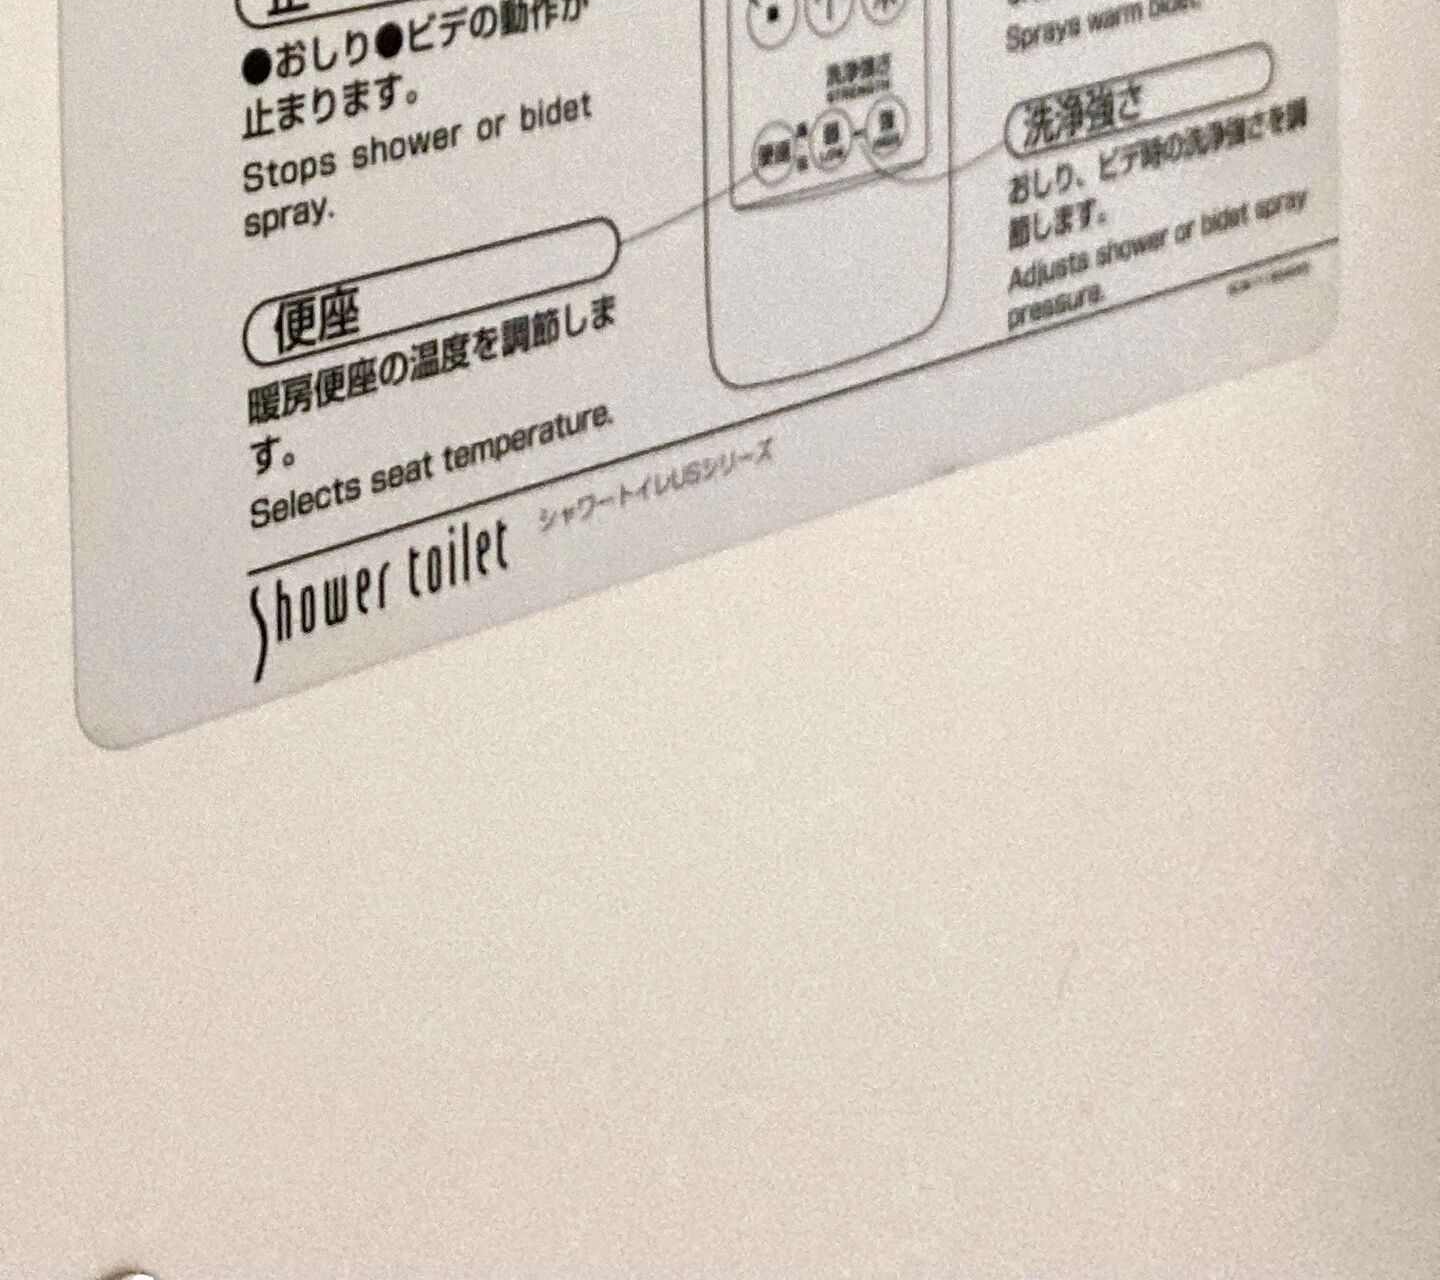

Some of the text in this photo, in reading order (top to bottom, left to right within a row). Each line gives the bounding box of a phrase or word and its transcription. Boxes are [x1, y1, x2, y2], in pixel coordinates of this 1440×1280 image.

[1006, 15, 1081, 53] Sprays
[1087, 2, 1143, 33] warm
[242, 72, 418, 139] 止まります。
[1023, 78, 1142, 147] 洗浄強さ
[243, 92, 593, 192] Stops shower or bidet
[244, 196, 335, 238] spray.
[1009, 190, 1308, 292] Adjusts shower or bidet spray
[273, 284, 360, 355] 便座
[247, 294, 617, 425] 暖房便座の温度を調節しま
[250, 435, 295, 474] す。
[250, 402, 614, 529] Selects seat temperature.
[250, 519, 509, 683] Shower toilet
